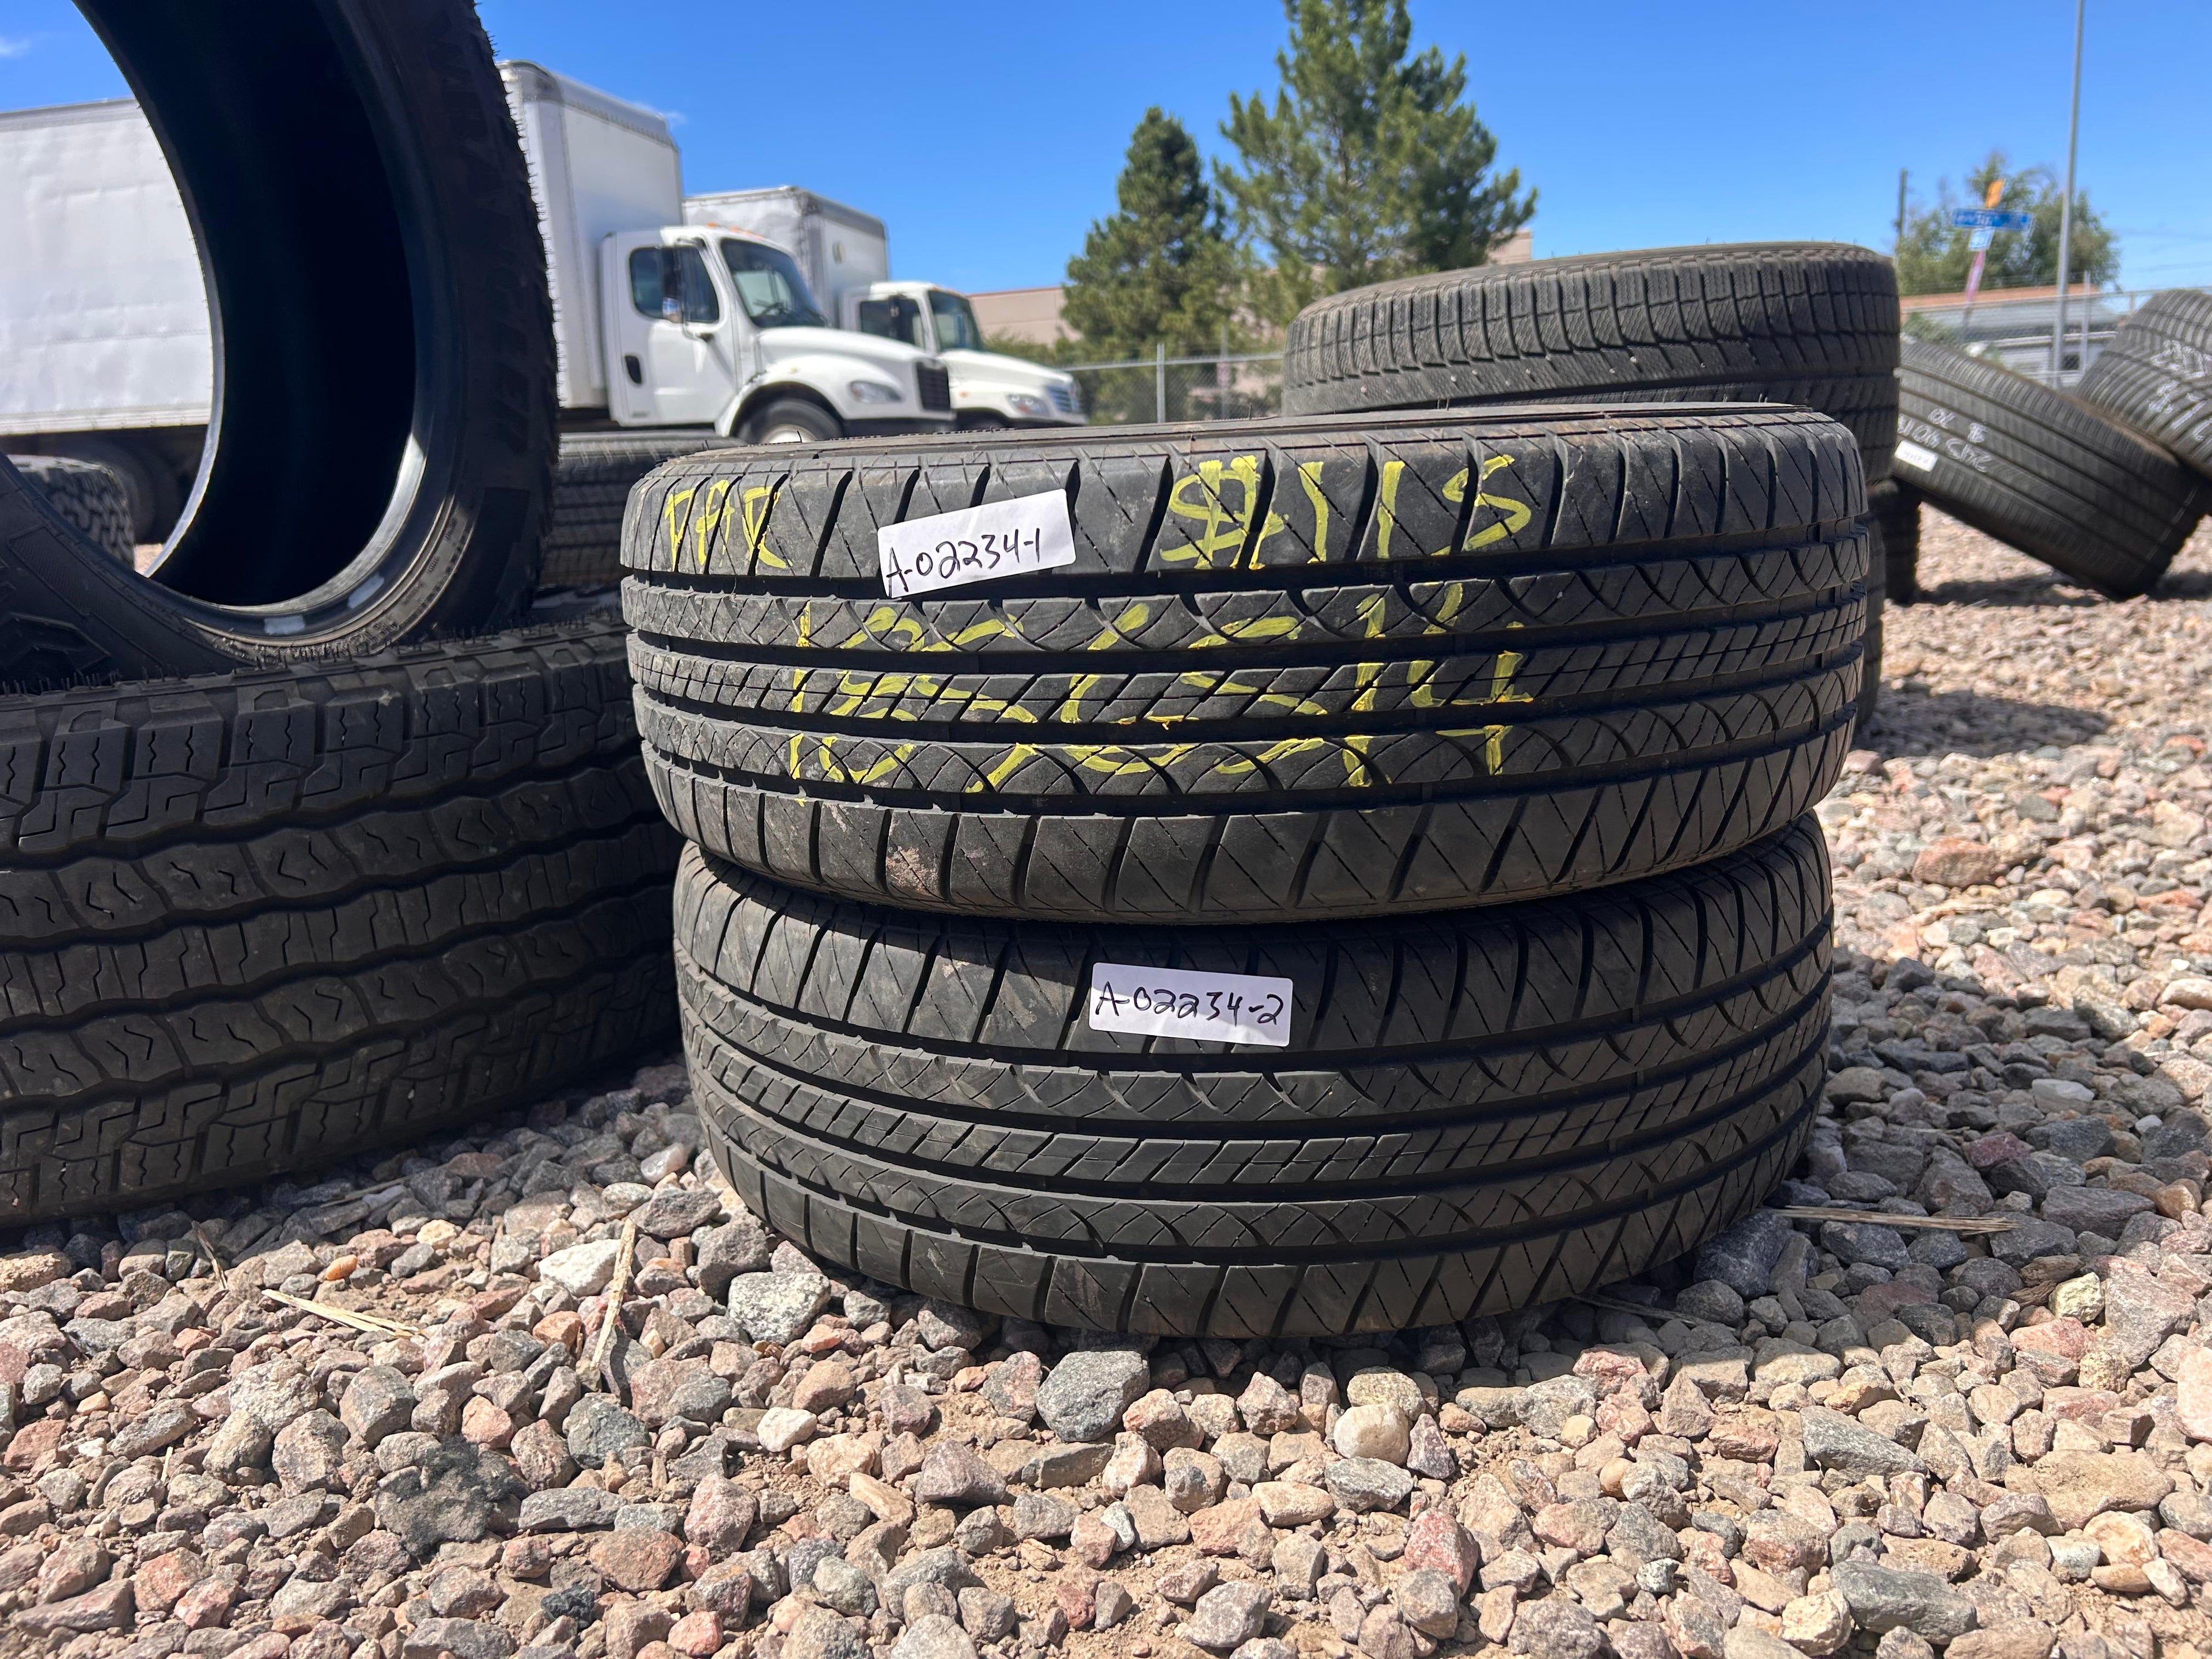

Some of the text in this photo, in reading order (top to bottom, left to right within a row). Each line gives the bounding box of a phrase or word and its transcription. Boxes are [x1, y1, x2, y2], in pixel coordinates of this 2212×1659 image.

[1160, 454, 1532, 571] $115
[886, 527, 1040, 597] A-02234-1
[1095, 980, 1283, 1027] A-02234-2
